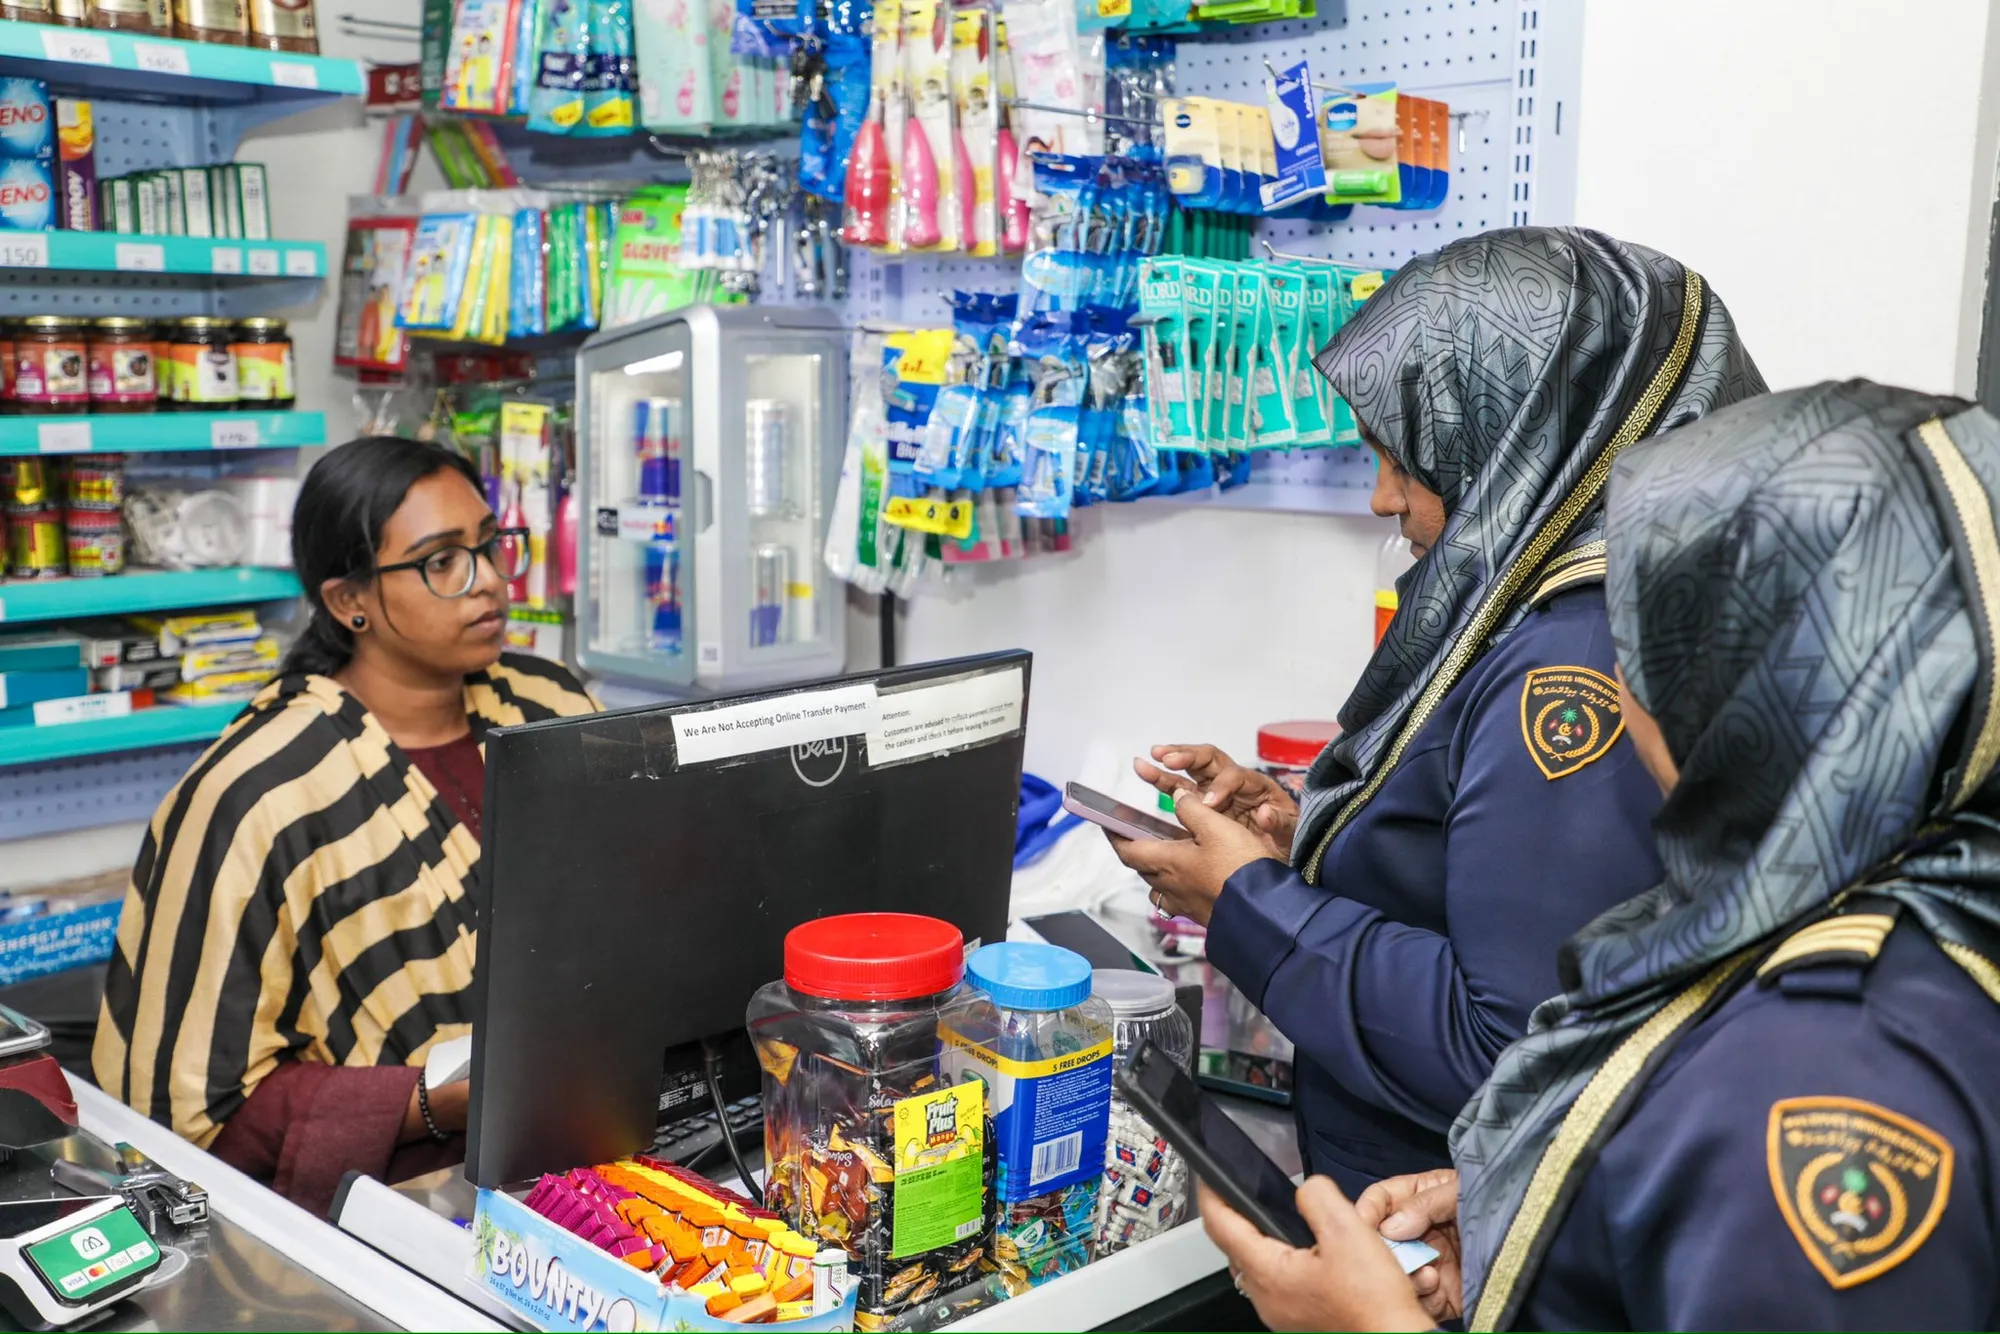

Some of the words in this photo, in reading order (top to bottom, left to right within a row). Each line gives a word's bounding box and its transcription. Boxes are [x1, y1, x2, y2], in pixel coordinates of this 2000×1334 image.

[0, 105, 45, 126] ENO
[0, 183, 49, 205] ENO
[1144, 281, 1181, 299] LORD
[1532, 675, 1573, 686] MALDIVES
[1574, 676, 1621, 704] IMMIGRATIO
[684, 727, 700, 738] We
[701, 724, 717, 735] Are
[718, 722, 734, 732] Not
[736, 714, 775, 730] Accepting
[775, 712, 801, 723] Online
[802, 707, 833, 719] Transfer
[834, 702, 866, 715] Payment
[883, 726, 914, 738] Customers
[924, 718, 944, 729] advised
[885, 741, 895, 750] the
[896, 737, 916, 748] cashier
[917, 734, 928, 743] and
[928, 731, 942, 741] check
[947, 726, 964, 736] before
[964, 722, 982, 732] leaving
[798, 736, 843, 760] DELL
[1053, 1063, 1058, 1073] 5
[1059, 1059, 1075, 1071] FREE
[1076, 1050, 1100, 1066] DROPS
[926, 1098, 958, 1120] Fruit
[929, 1115, 955, 1134] Plus
[930, 1132, 954, 1143] Mango
[67, 1276, 84, 1287] VISA
[492, 1231, 604, 1332] BOUNTY
